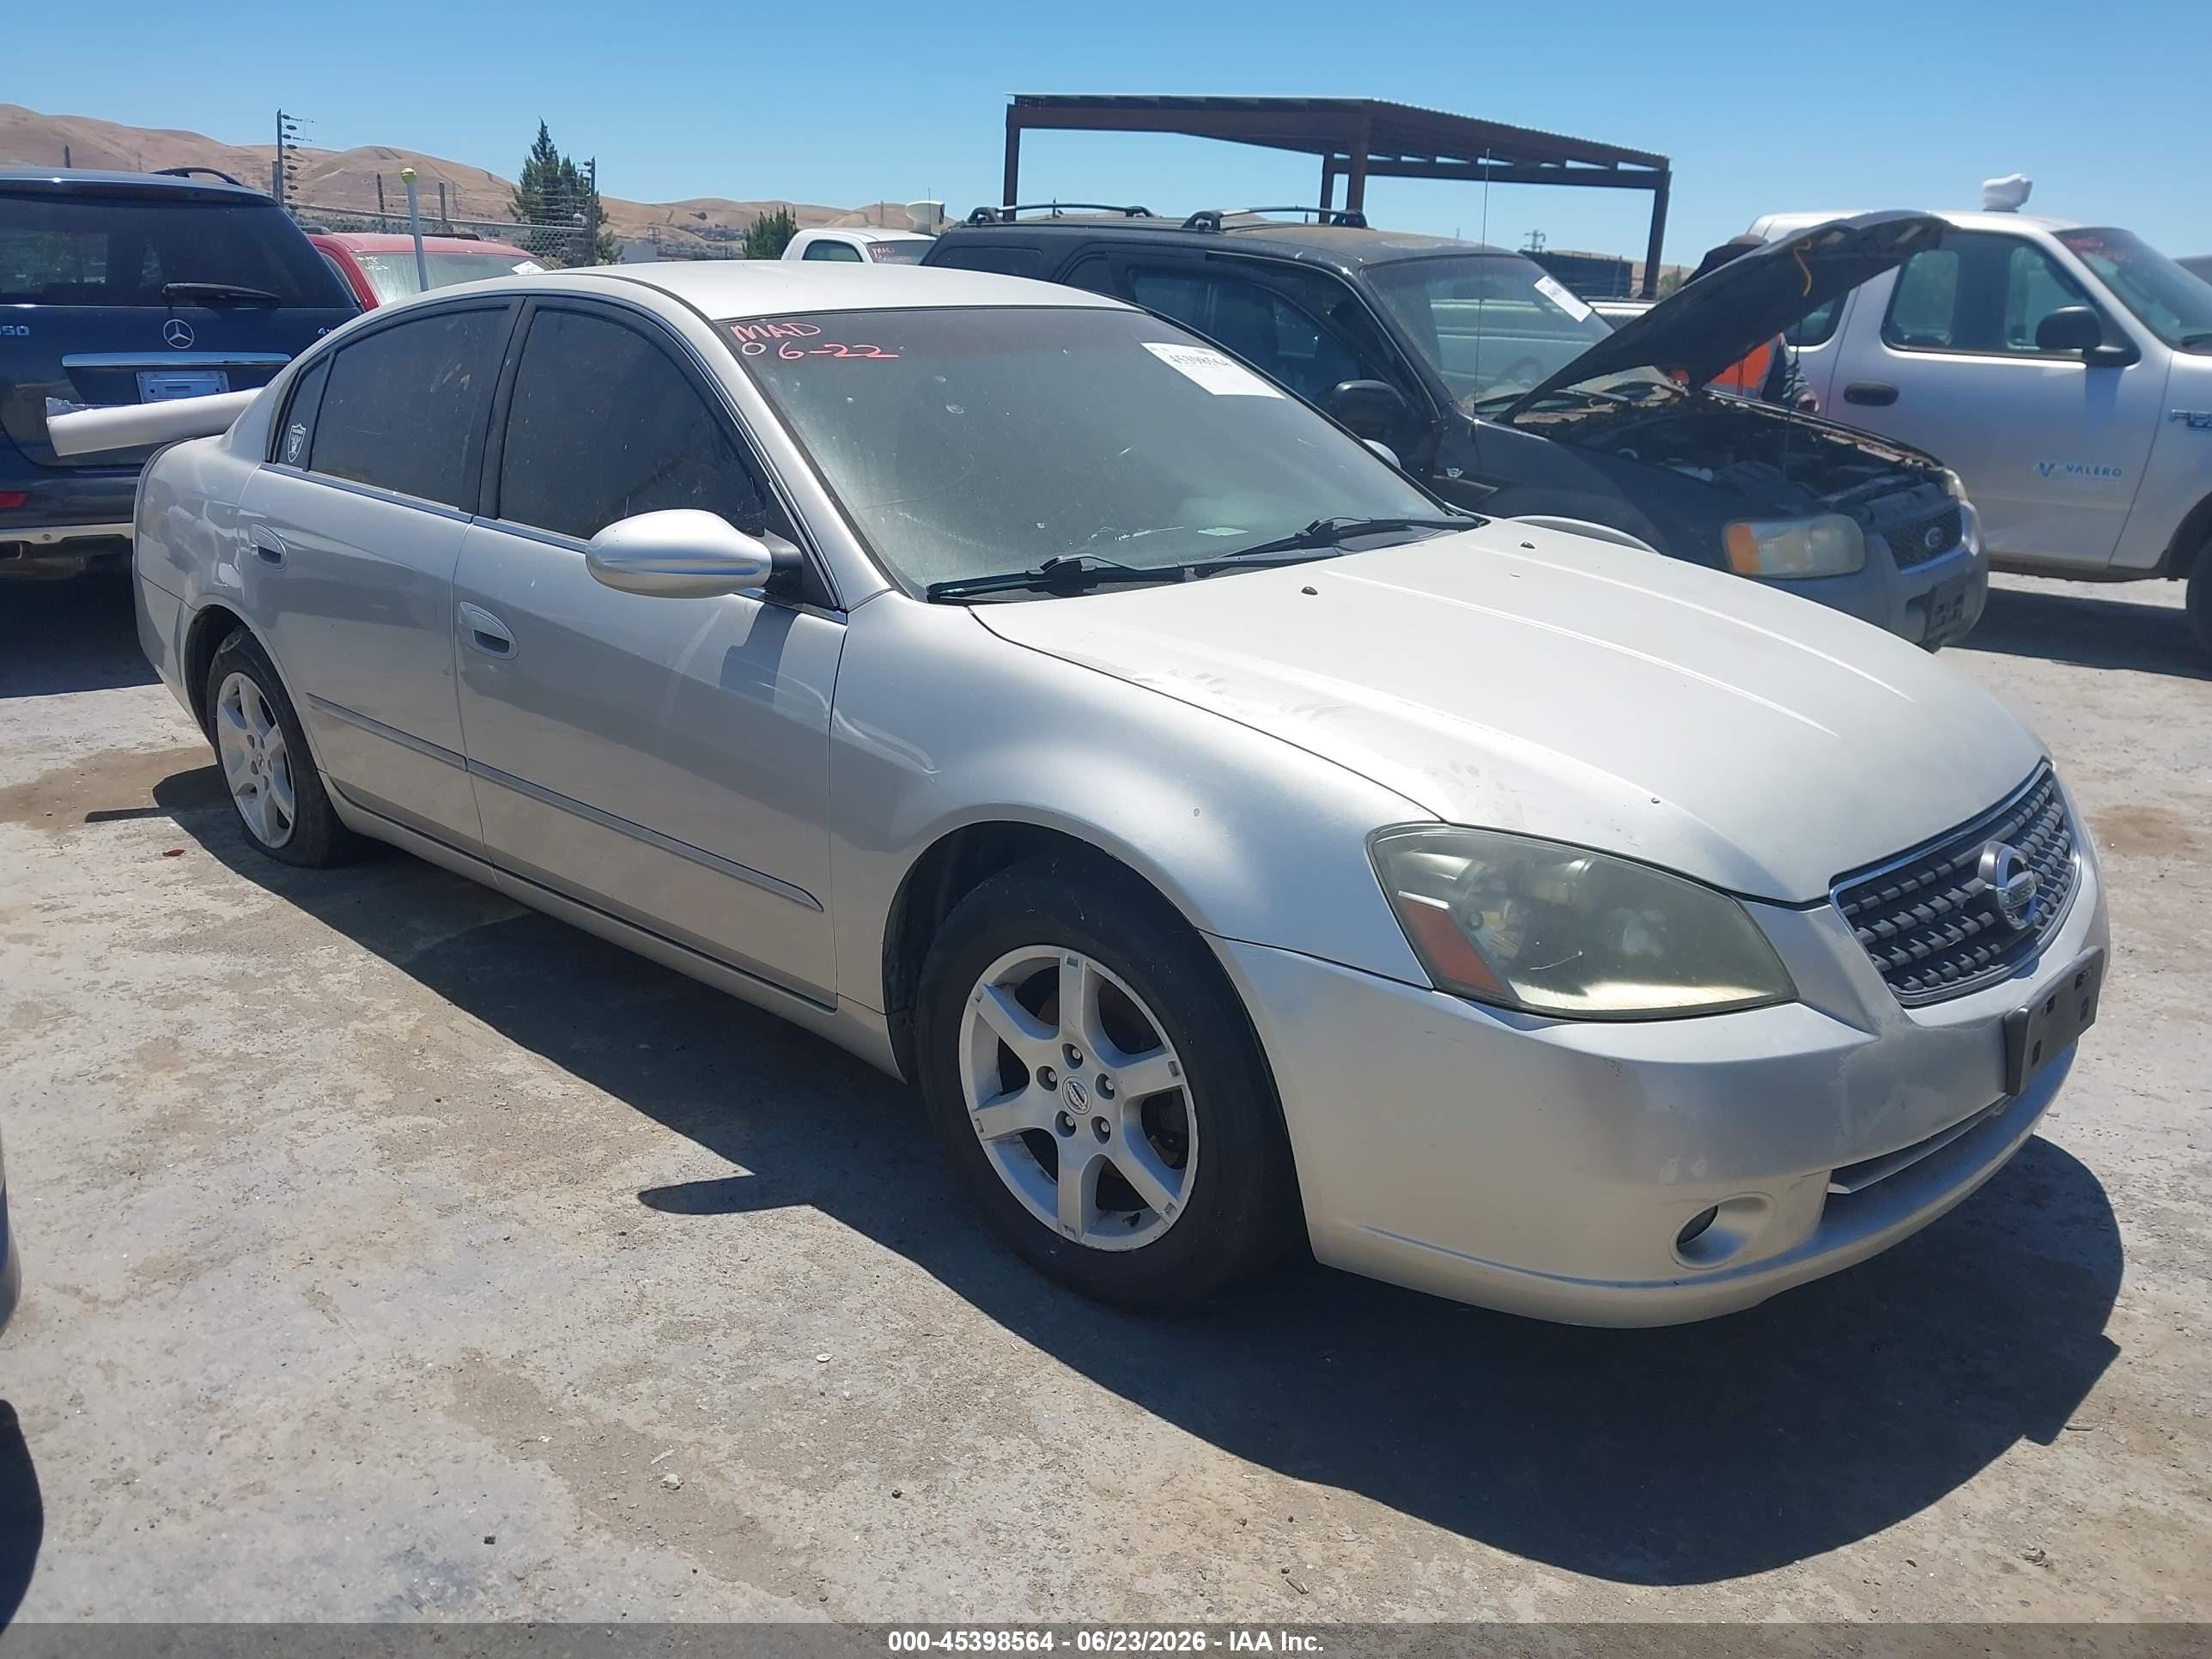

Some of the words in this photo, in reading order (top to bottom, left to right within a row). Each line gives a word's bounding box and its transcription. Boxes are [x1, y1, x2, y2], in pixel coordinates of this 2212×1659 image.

[0, 325, 30, 336] 50
[730, 322, 822, 342] MAD
[2066, 464, 2122, 477] VALERO
